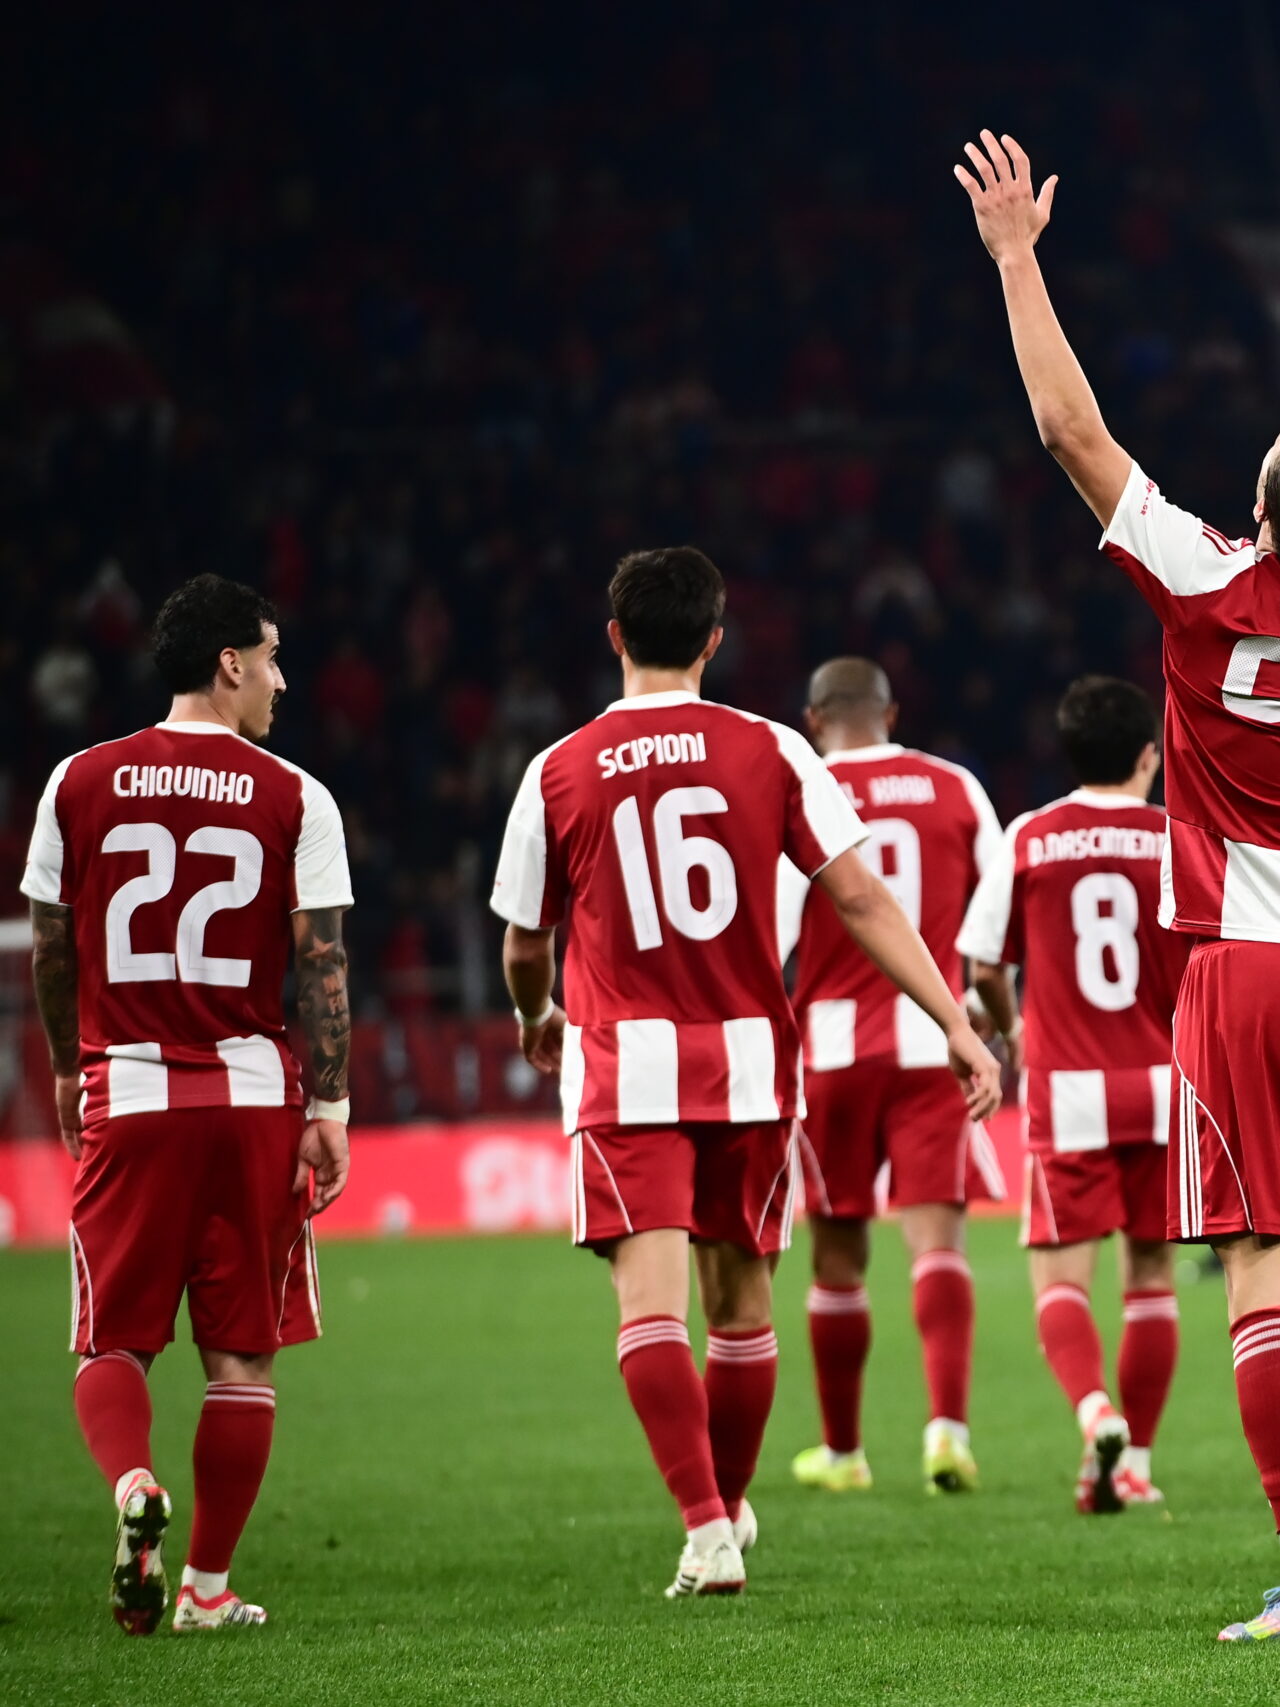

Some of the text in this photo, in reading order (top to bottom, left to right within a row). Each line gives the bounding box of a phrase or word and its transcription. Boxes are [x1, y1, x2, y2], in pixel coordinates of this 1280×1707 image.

[113, 765, 254, 805] CHIQUINHO
[597, 732, 707, 779] SCIPIONI
[612, 785, 738, 951] 16
[1027, 827, 1165, 868] D.NASCIMENT
[101, 822, 264, 987] 22
[1071, 872, 1140, 1012] 8
